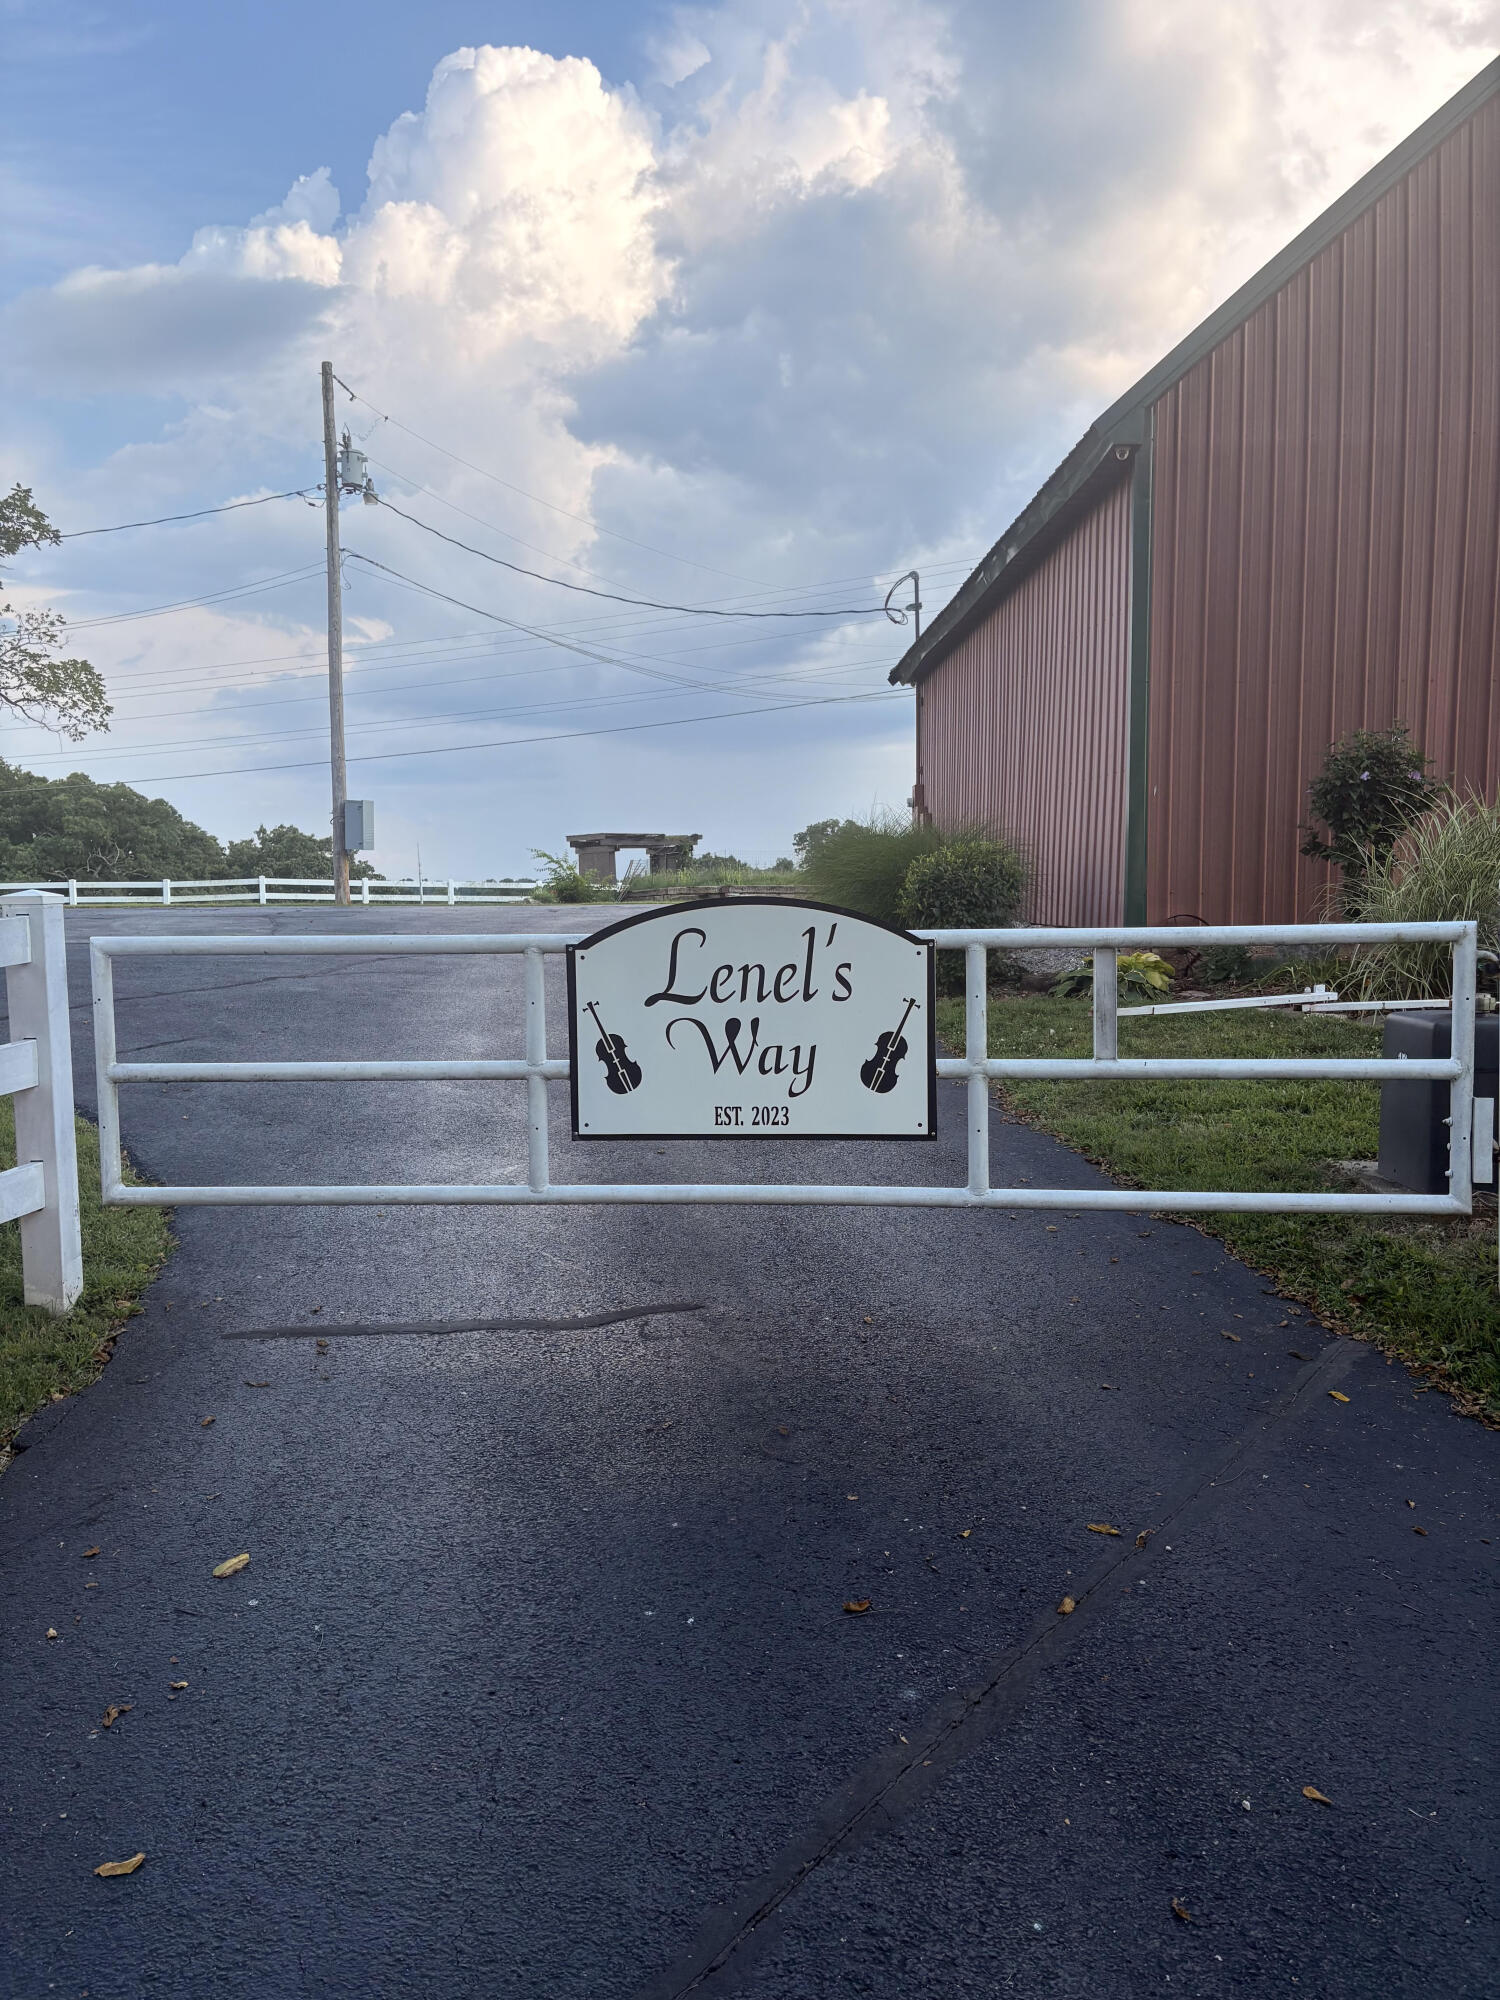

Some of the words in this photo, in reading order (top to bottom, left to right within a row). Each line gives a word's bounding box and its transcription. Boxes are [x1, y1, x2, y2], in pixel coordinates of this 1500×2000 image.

[643, 922, 853, 1008] Lenel's
[665, 1016, 817, 1098] Way
[714, 1106, 744, 1127] EST.
[751, 1106, 790, 1127] 2023
